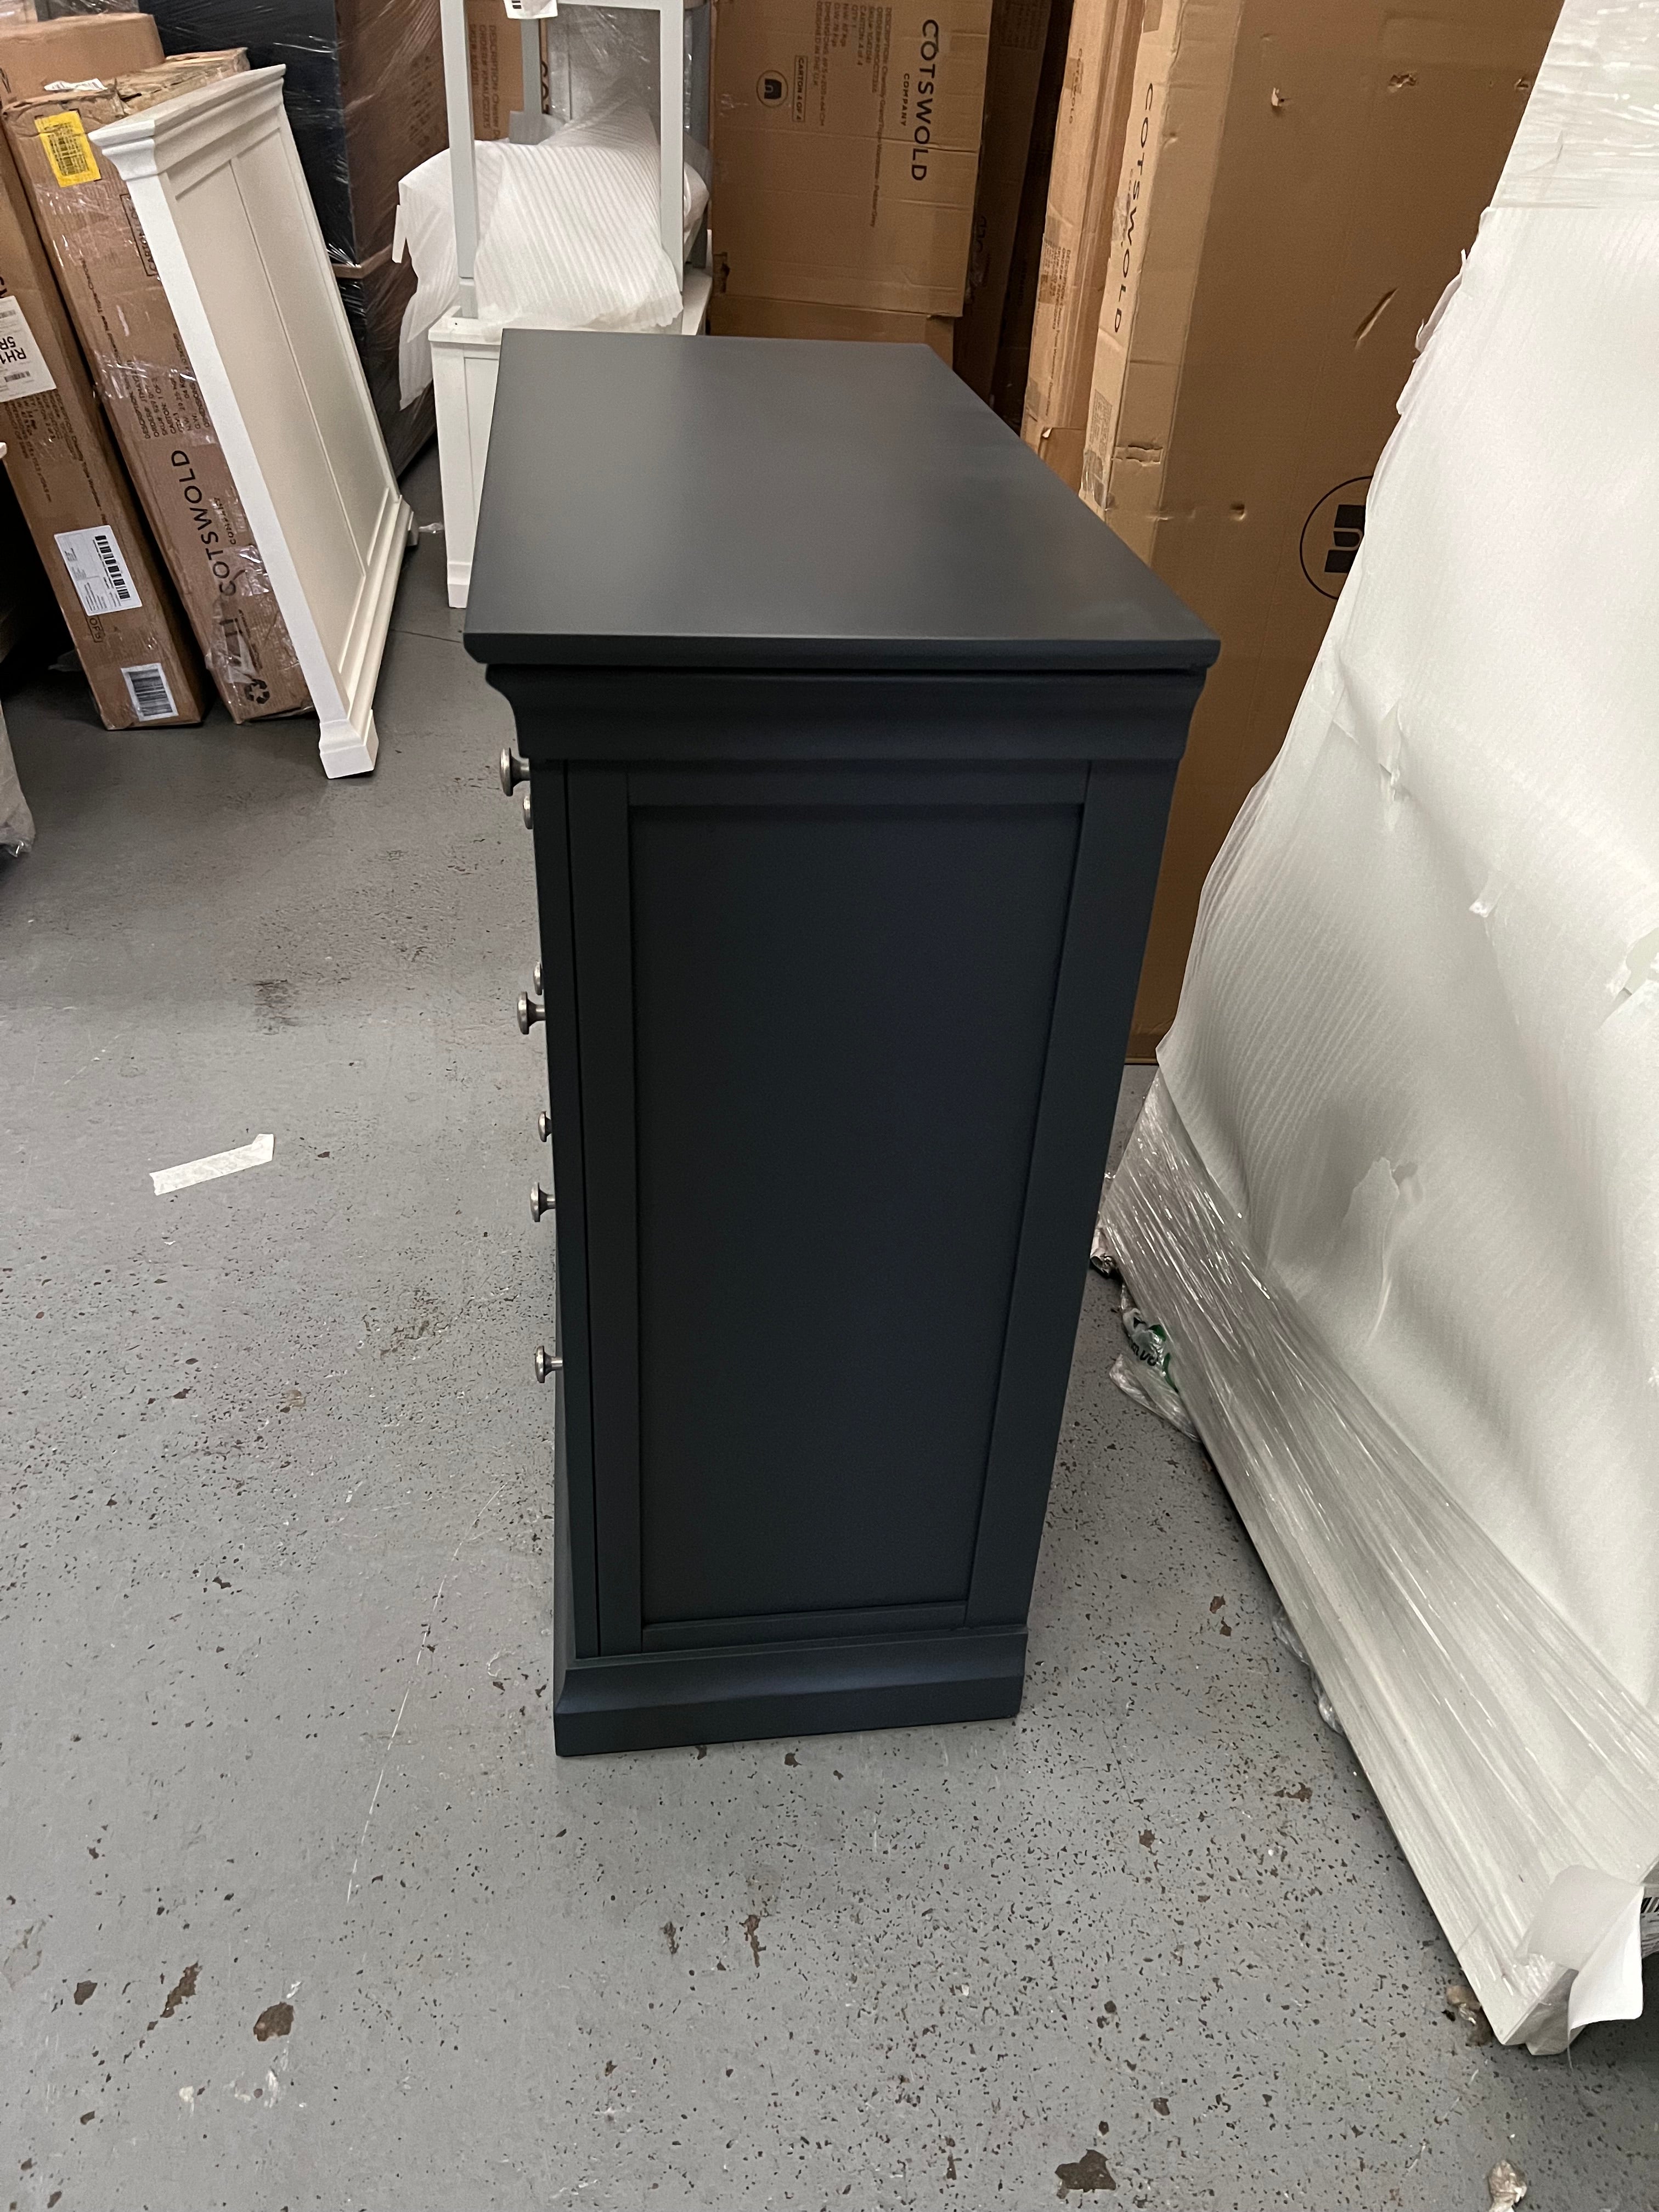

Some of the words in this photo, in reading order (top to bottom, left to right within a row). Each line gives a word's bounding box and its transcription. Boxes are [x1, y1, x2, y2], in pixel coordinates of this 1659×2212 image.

[795, 101, 802, 114] OF
[900, 72, 911, 127] COMPANY
[911, 19, 939, 181] COTSWOLD
[1114, 82, 1153, 333] COTSWOLD
[153, 382, 162, 394] OF
[143, 405, 160, 438] ORDER#
[156, 416, 168, 436] SKU#
[171, 450, 236, 597] COTSWOLD
[213, 496, 237, 545] COMPANY
[89, 617, 101, 632] OF
